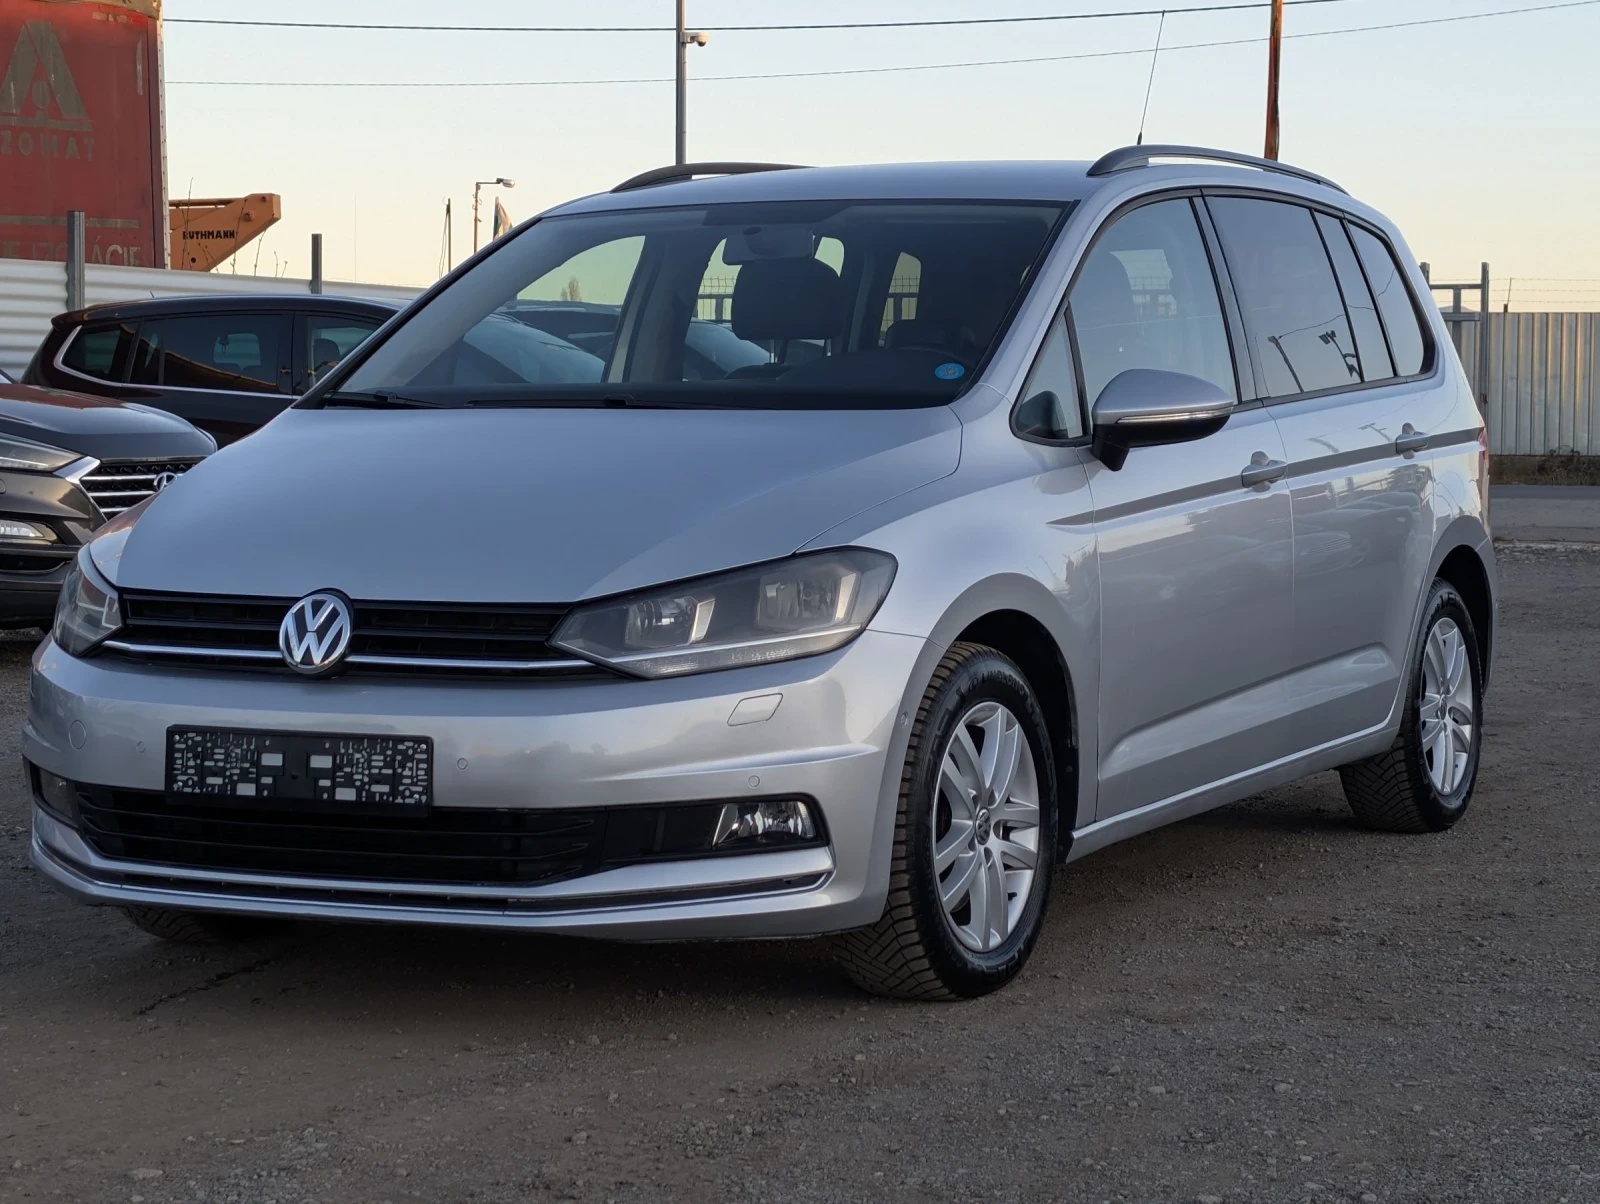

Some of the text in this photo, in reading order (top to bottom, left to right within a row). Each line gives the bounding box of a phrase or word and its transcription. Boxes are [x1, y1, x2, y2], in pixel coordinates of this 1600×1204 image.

[32, 235, 141, 267] IZÁCIE
[182, 229, 236, 241] RUTHMANN
[282, 595, 349, 671] VW
